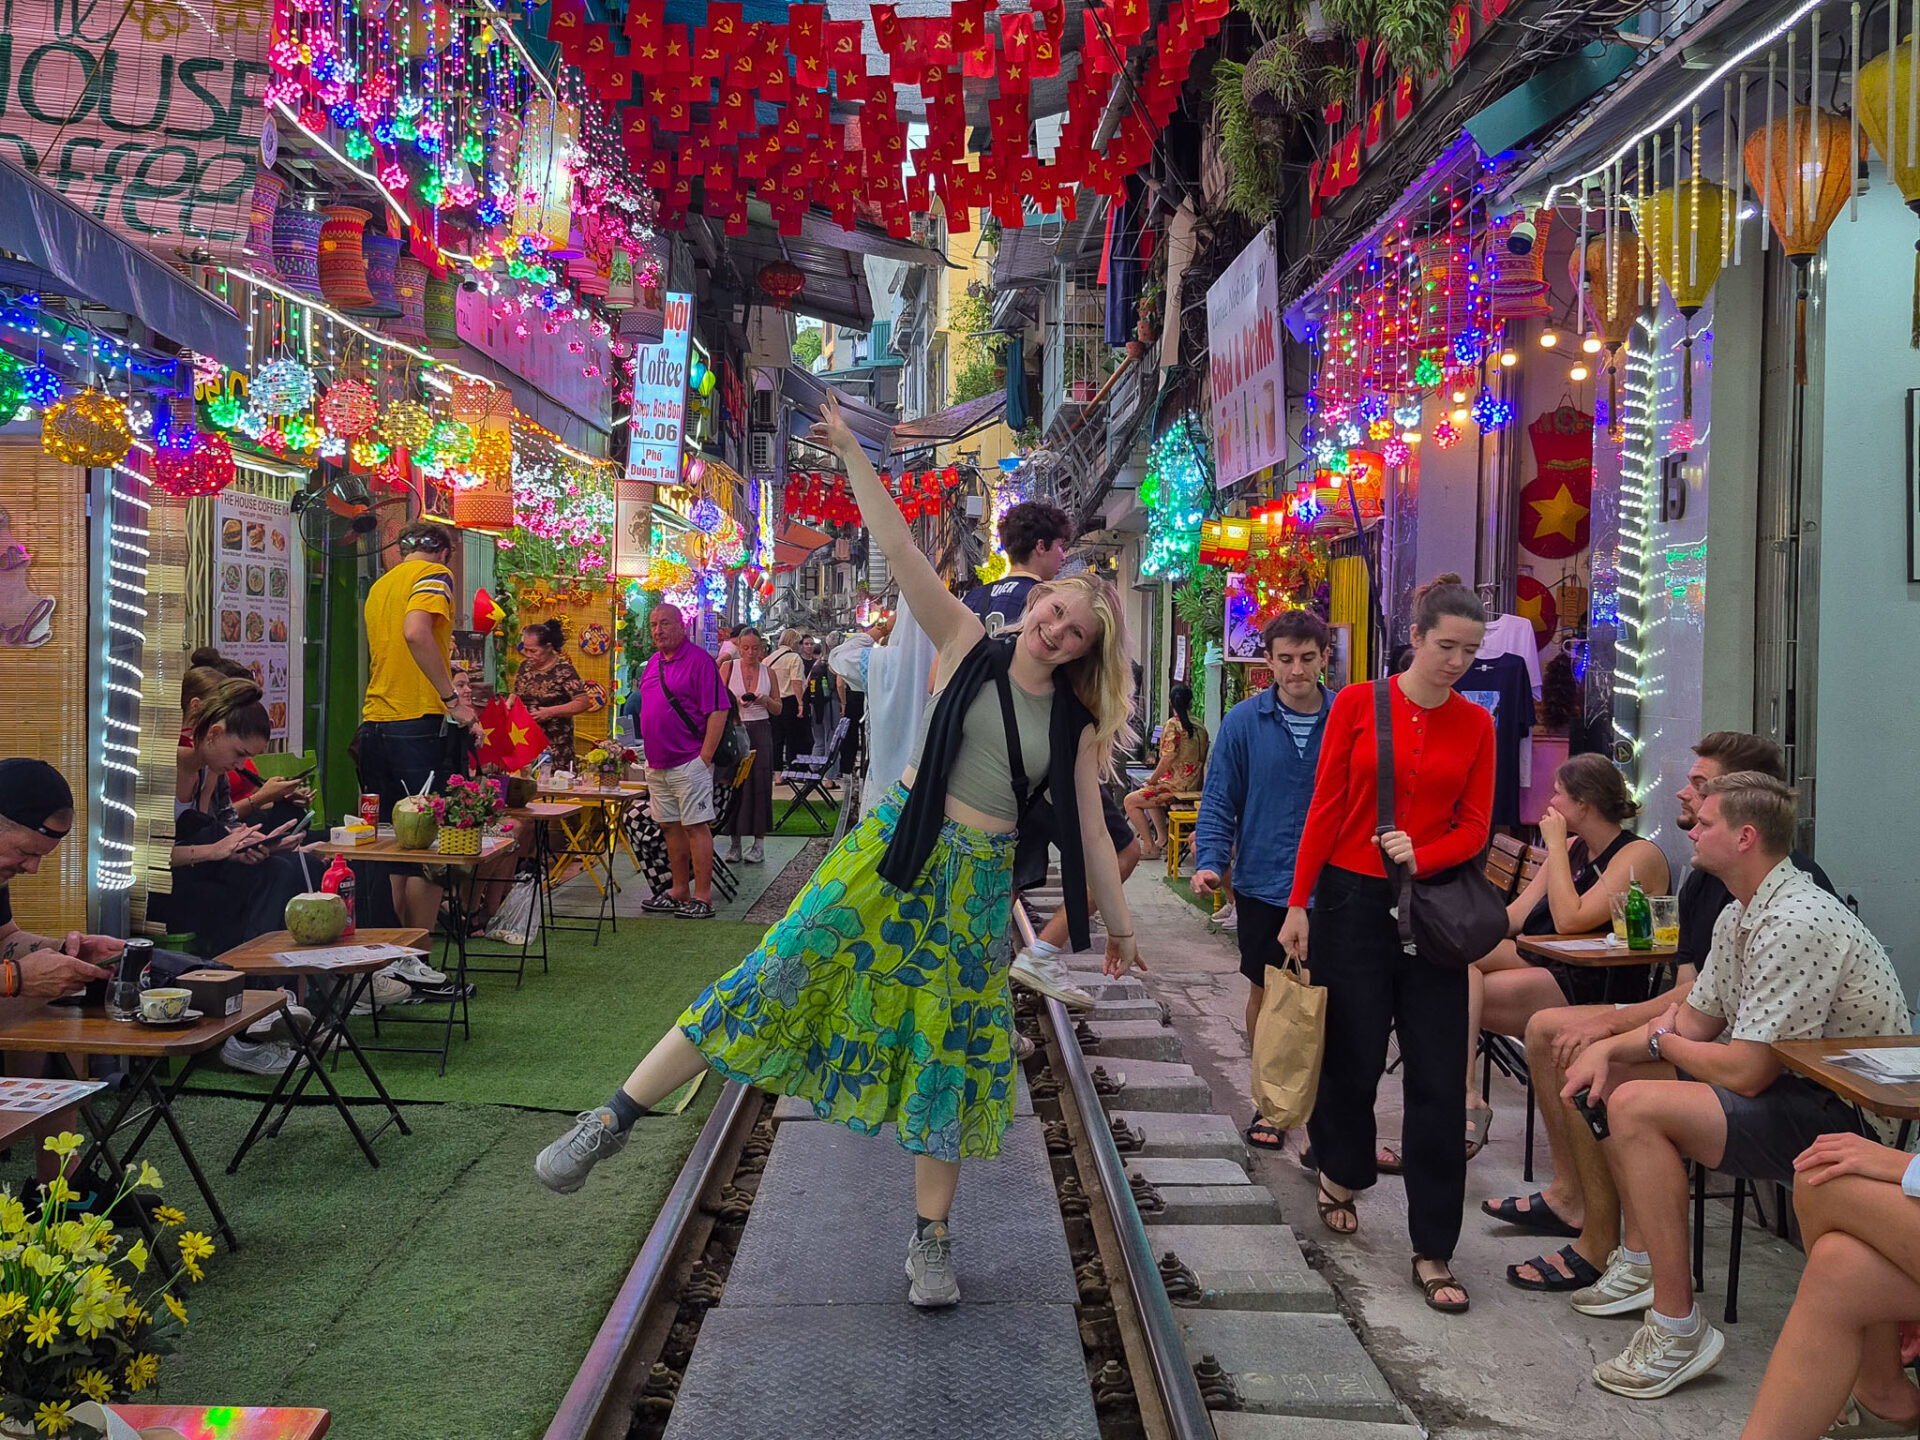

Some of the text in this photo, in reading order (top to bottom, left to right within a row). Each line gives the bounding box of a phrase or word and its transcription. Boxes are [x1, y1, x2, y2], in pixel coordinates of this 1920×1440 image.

[639, 346, 682, 388] Coffee
[1212, 338, 1233, 404] Food
[1242, 305, 1275, 381] Drink
[234, 496, 257, 511] HOUSE
[257, 500, 282, 516] COFFEE
[1659, 453, 1687, 522] 15
